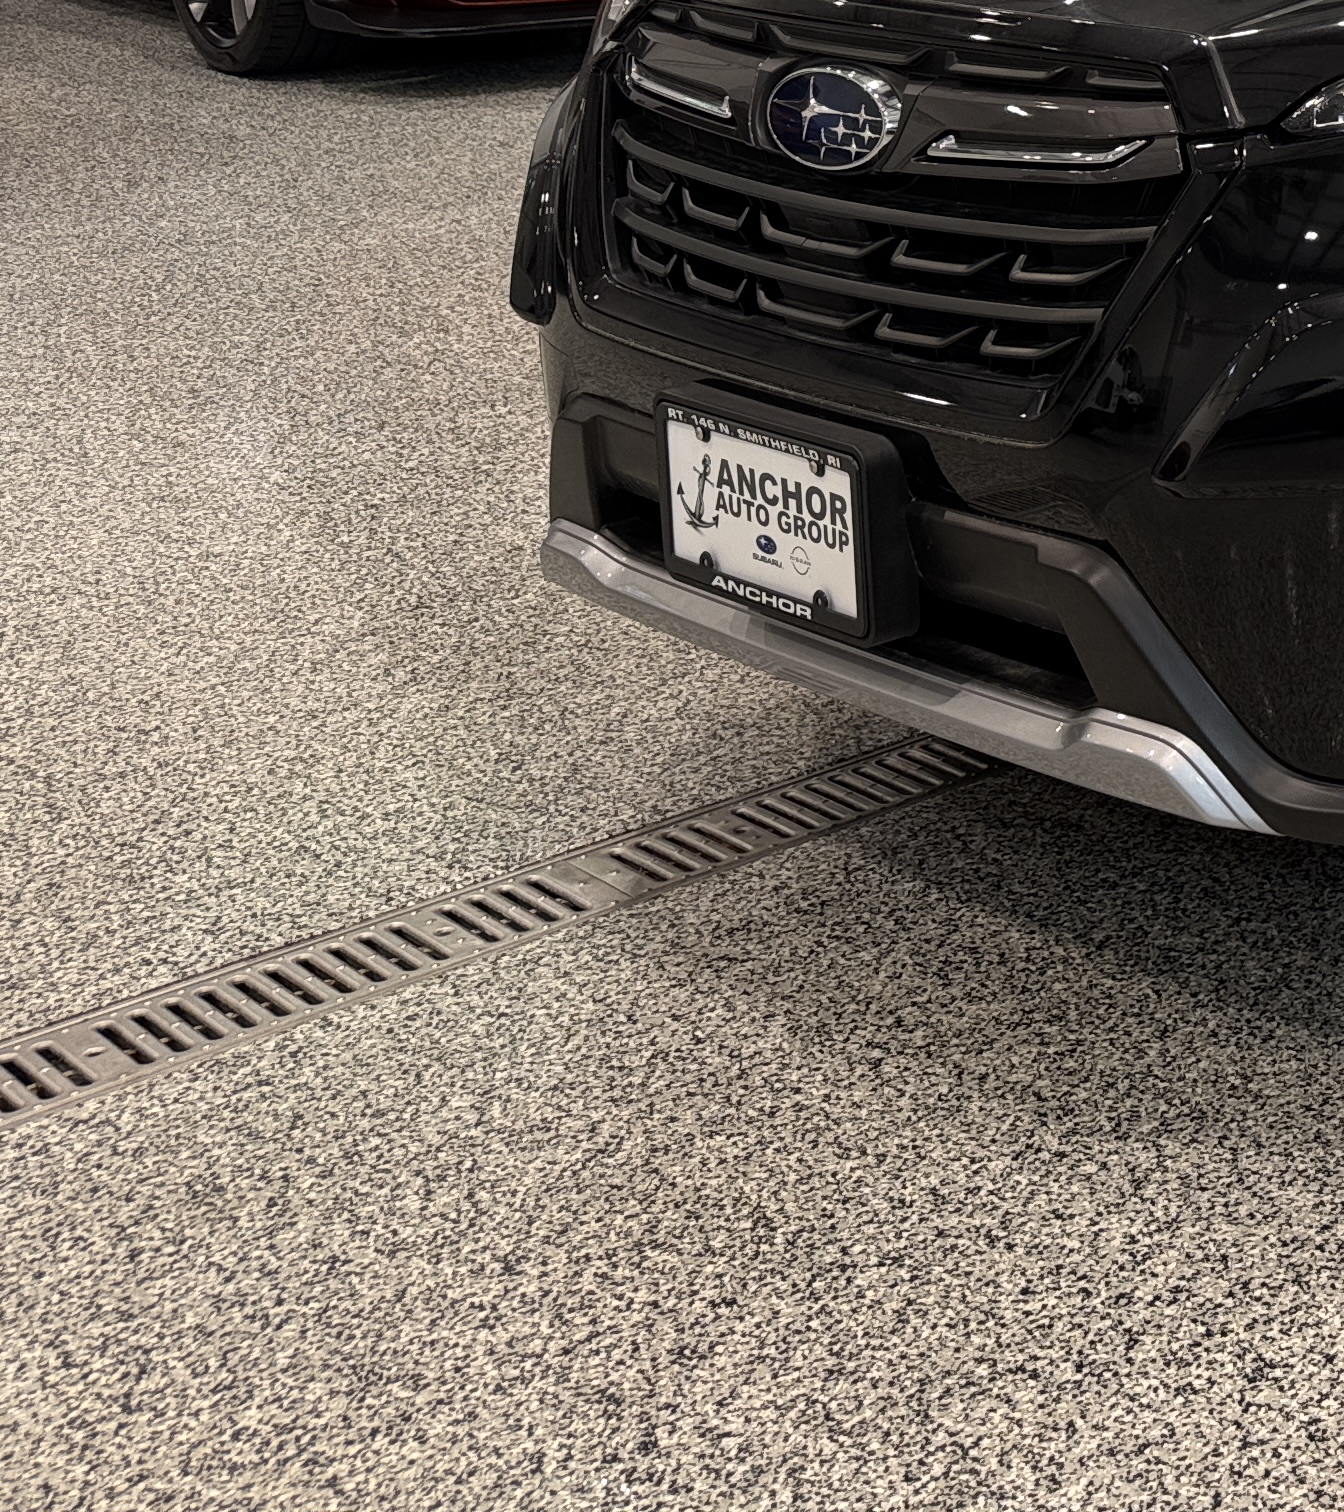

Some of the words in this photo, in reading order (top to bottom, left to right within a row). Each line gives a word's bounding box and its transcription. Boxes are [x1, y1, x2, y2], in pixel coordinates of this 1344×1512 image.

[691, 414, 716, 430] 146
[826, 454, 841, 469] RI
[715, 491, 770, 527] AUTO
[777, 511, 850, 553] GROUP
[716, 458, 849, 531] ANCHOR
[711, 575, 812, 620] ANCHOR
